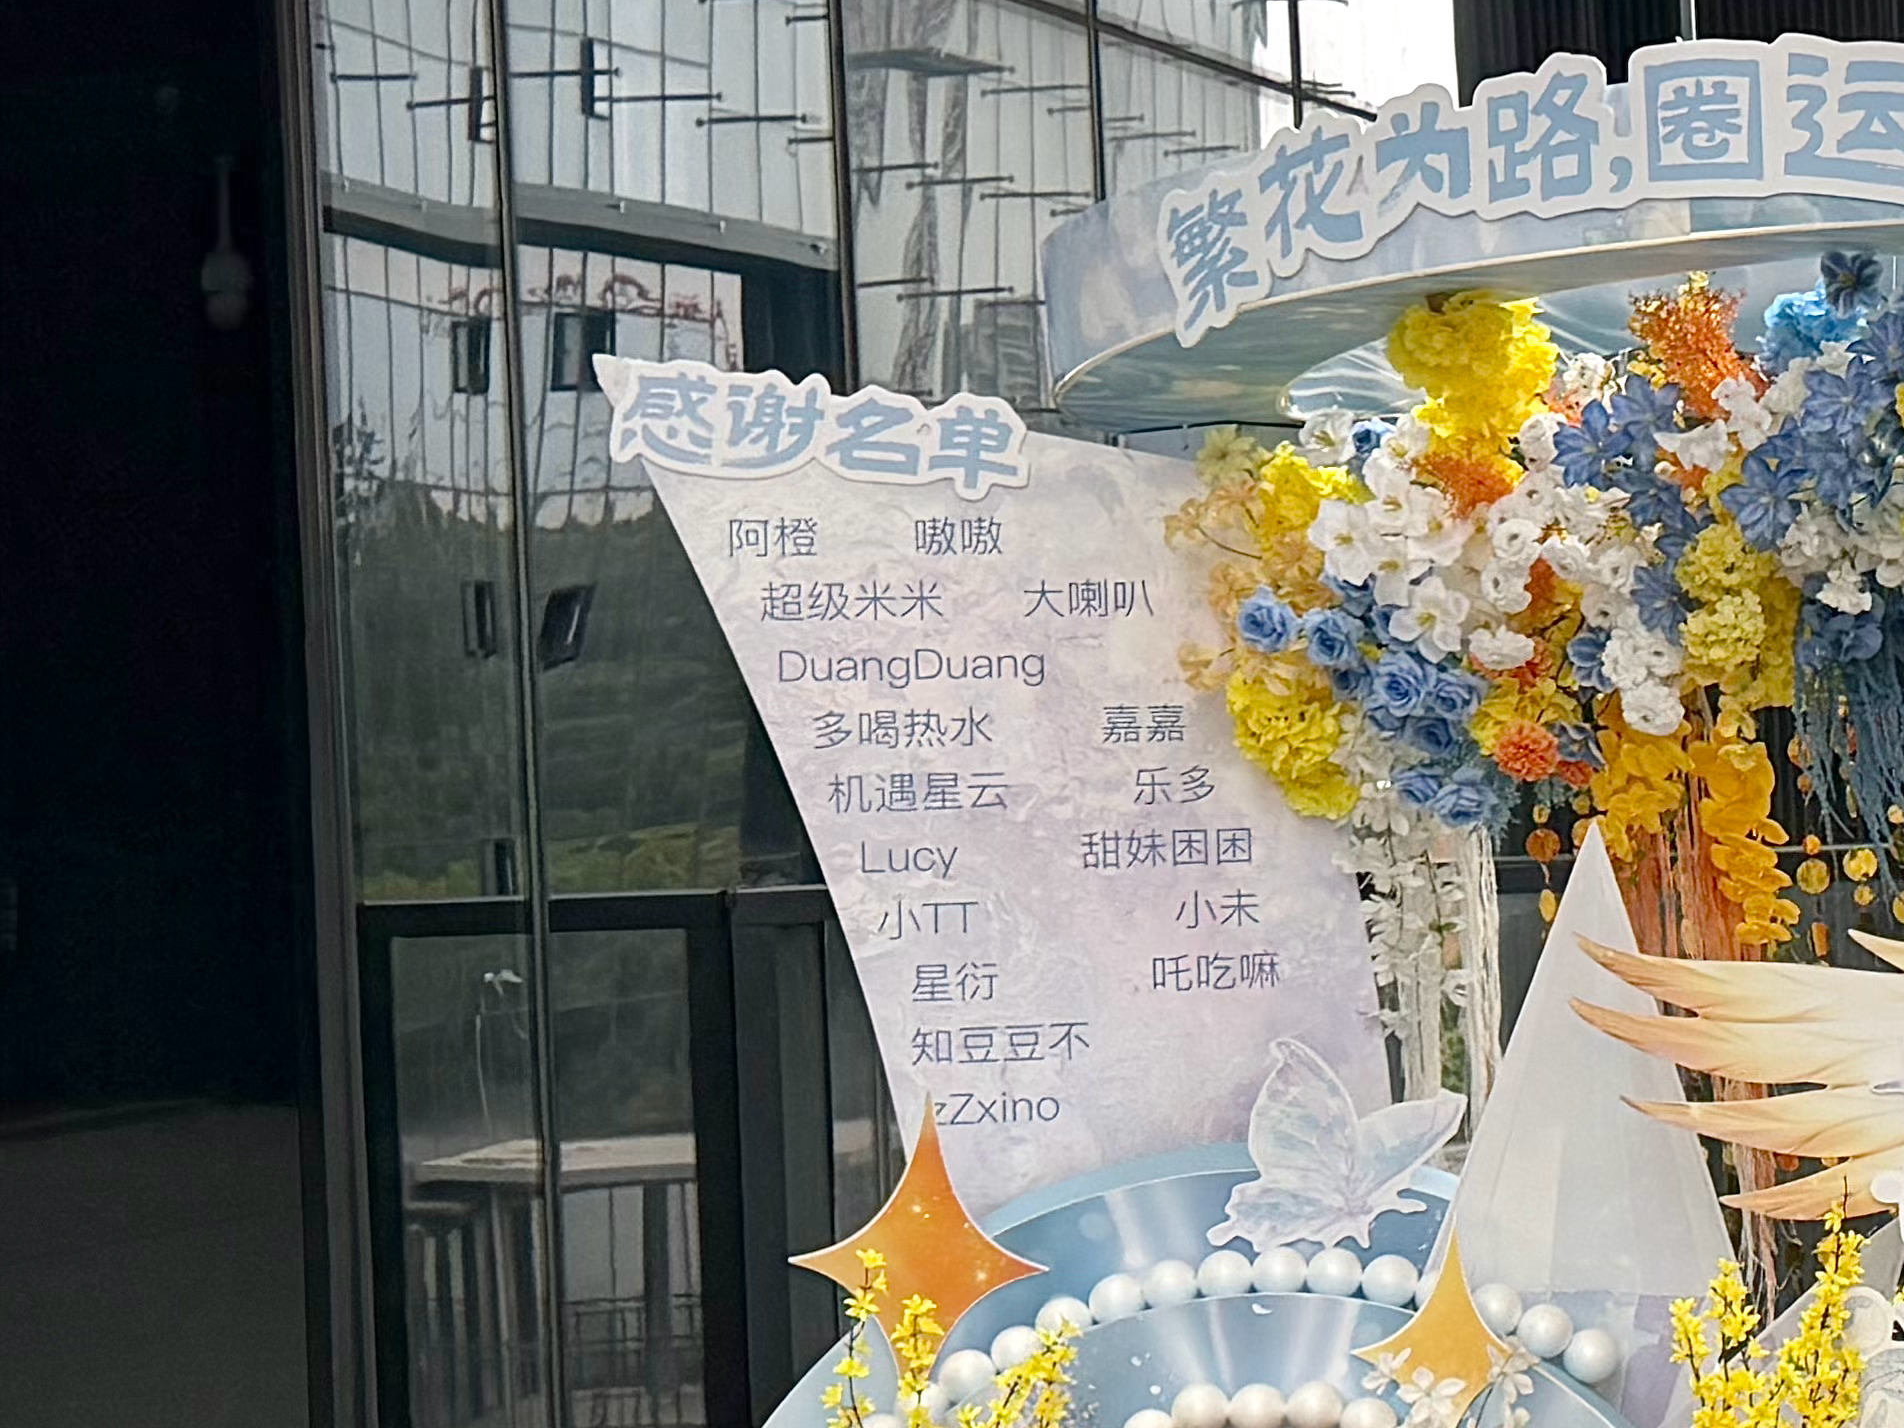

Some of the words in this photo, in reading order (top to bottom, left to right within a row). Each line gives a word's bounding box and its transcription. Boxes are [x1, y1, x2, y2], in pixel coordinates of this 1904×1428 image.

[620, 374, 1019, 489] 感谢名单
[729, 517, 818, 557] 阿橙
[915, 517, 1003, 556] 嗷嗷
[760, 580, 944, 622] 超级米米
[1024, 578, 1155, 618] 大喇叭
[779, 649, 1046, 689] DuangDuang
[813, 706, 993, 749] 多喝热水
[1102, 704, 1185, 743] 嘉嘉
[828, 771, 1008, 814] 机遇星云
[1134, 766, 1215, 806] 乐多
[861, 841, 958, 878] Lucy
[1081, 828, 1253, 869] 甜妹困困
[1175, 888, 1261, 929] 小未
[912, 963, 999, 1003] 星衍
[1152, 950, 1281, 991] 吒吃嘛
[912, 1021, 1090, 1066] 知豆豆不
